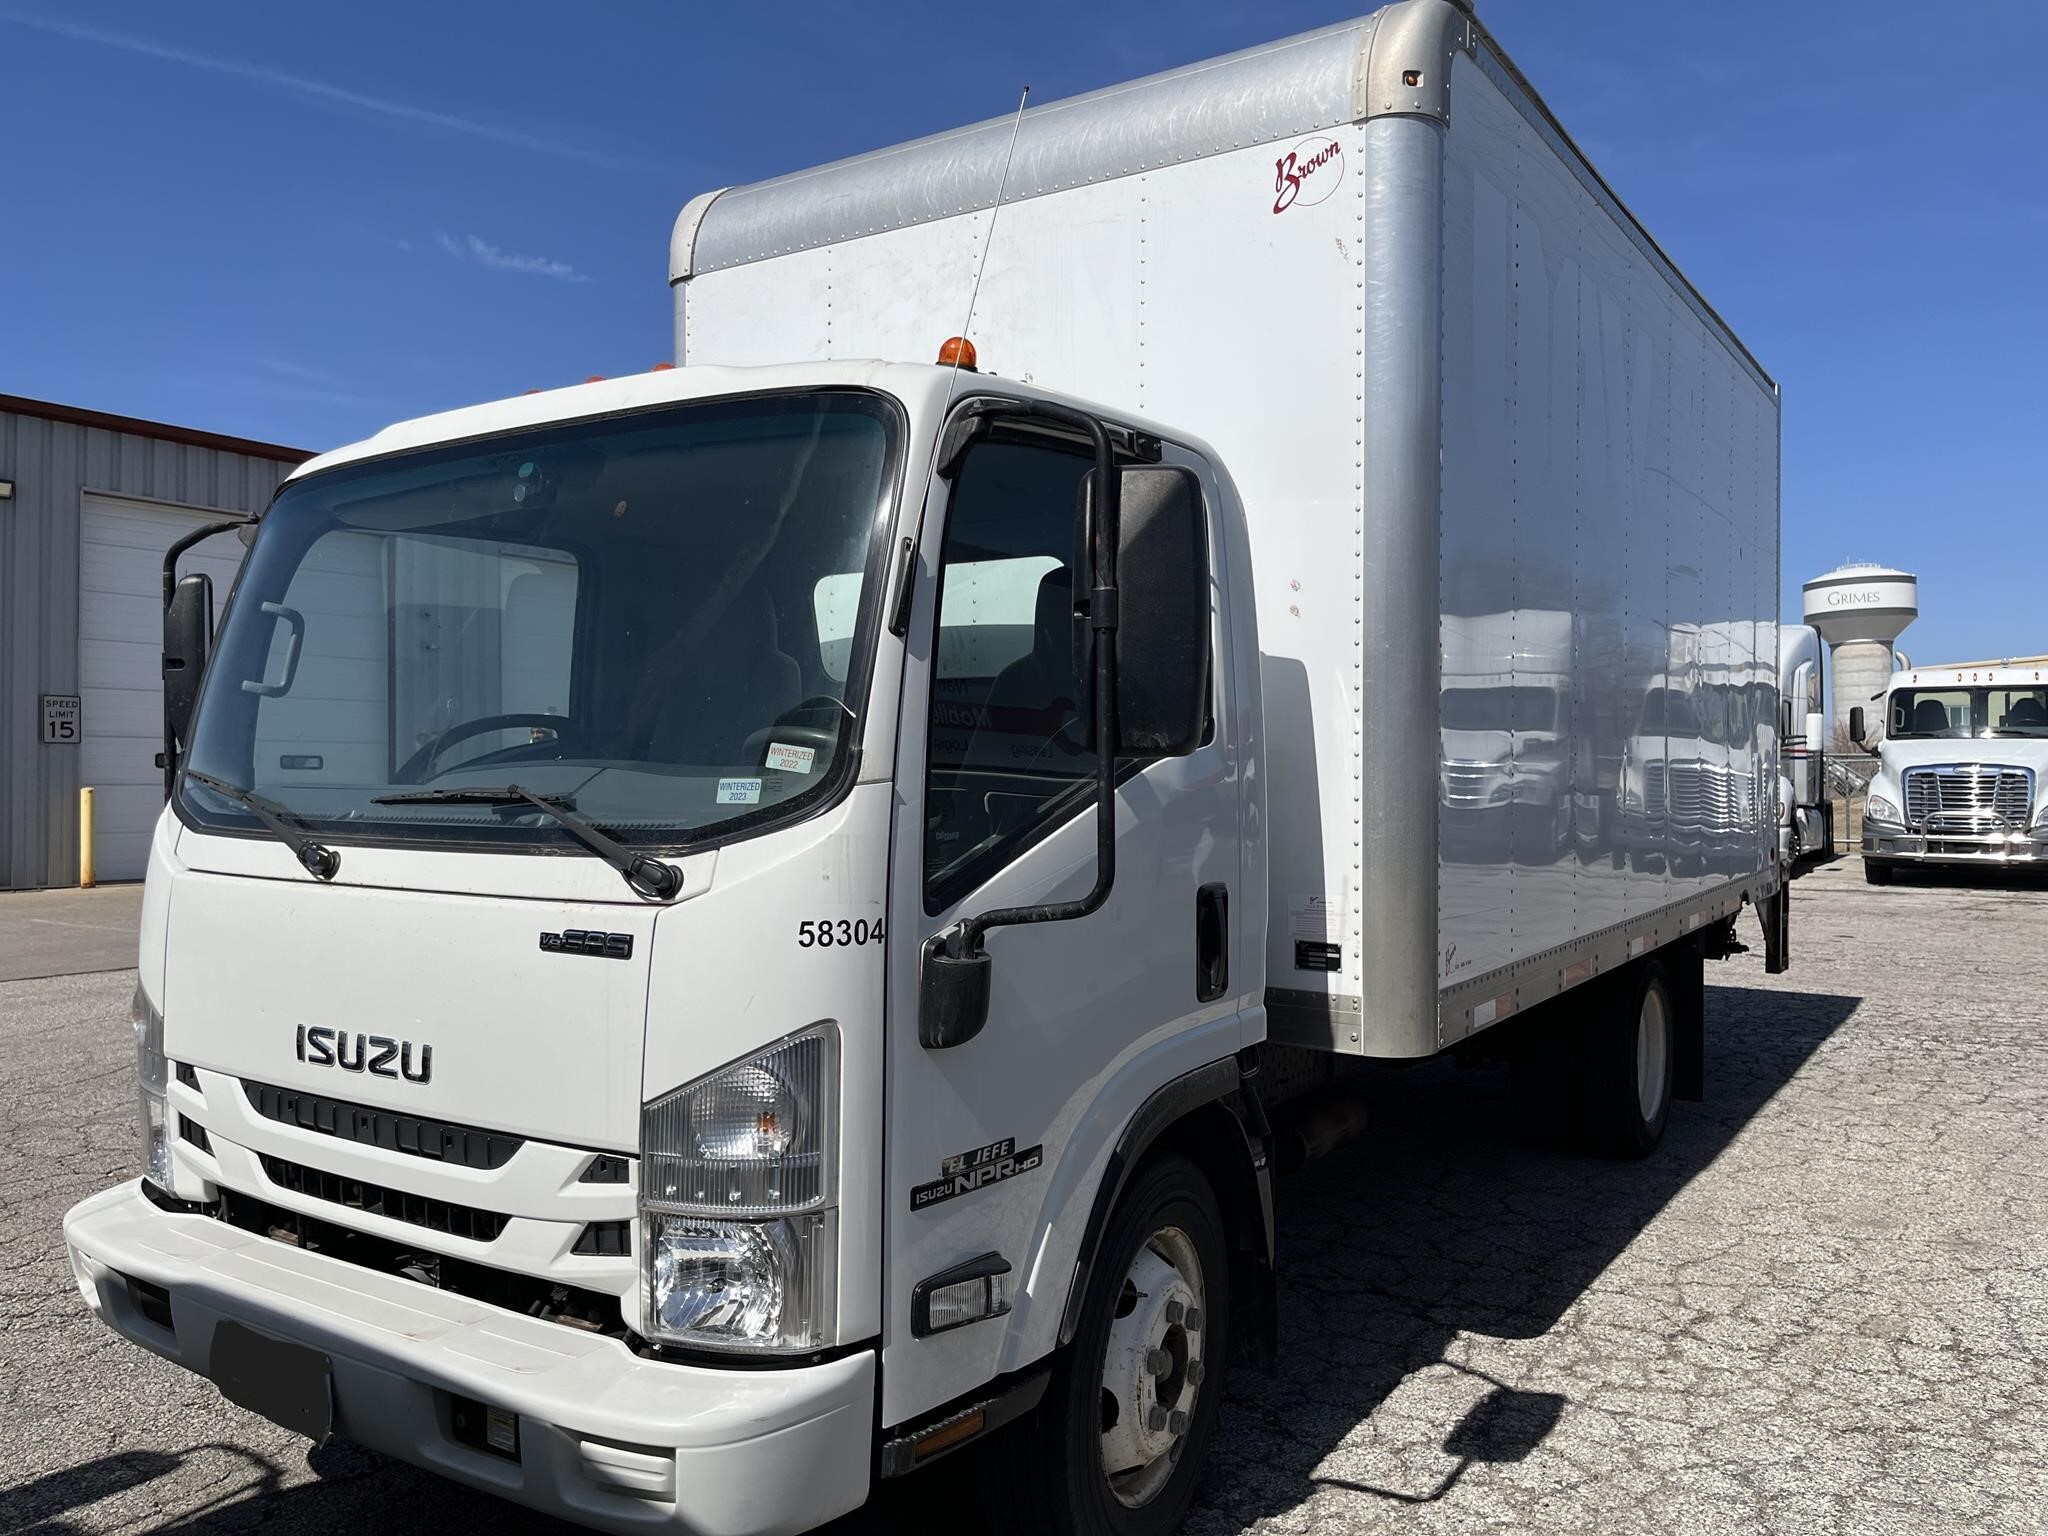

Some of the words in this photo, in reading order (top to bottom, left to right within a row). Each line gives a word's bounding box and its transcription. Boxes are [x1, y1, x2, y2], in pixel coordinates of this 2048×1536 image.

[1272, 141, 1341, 215] Brown
[45, 700, 79, 709] SPEED
[49, 710, 75, 719] LIMIT
[49, 720, 75, 739] 15
[770, 746, 814, 761] WINTERIZED
[779, 758, 799, 770] 2022
[719, 781, 761, 792] WINTERIZED
[728, 792, 748, 802] 2023
[798, 917, 885, 948] 58304
[296, 1023, 433, 1085] ISUZU
[948, 1155, 968, 1174] EL
[972, 1140, 1011, 1167] JEFE
[916, 1183, 953, 1205] ISUZU
[954, 1158, 1015, 1195] NPR
[1015, 1156, 1040, 1174] HD
